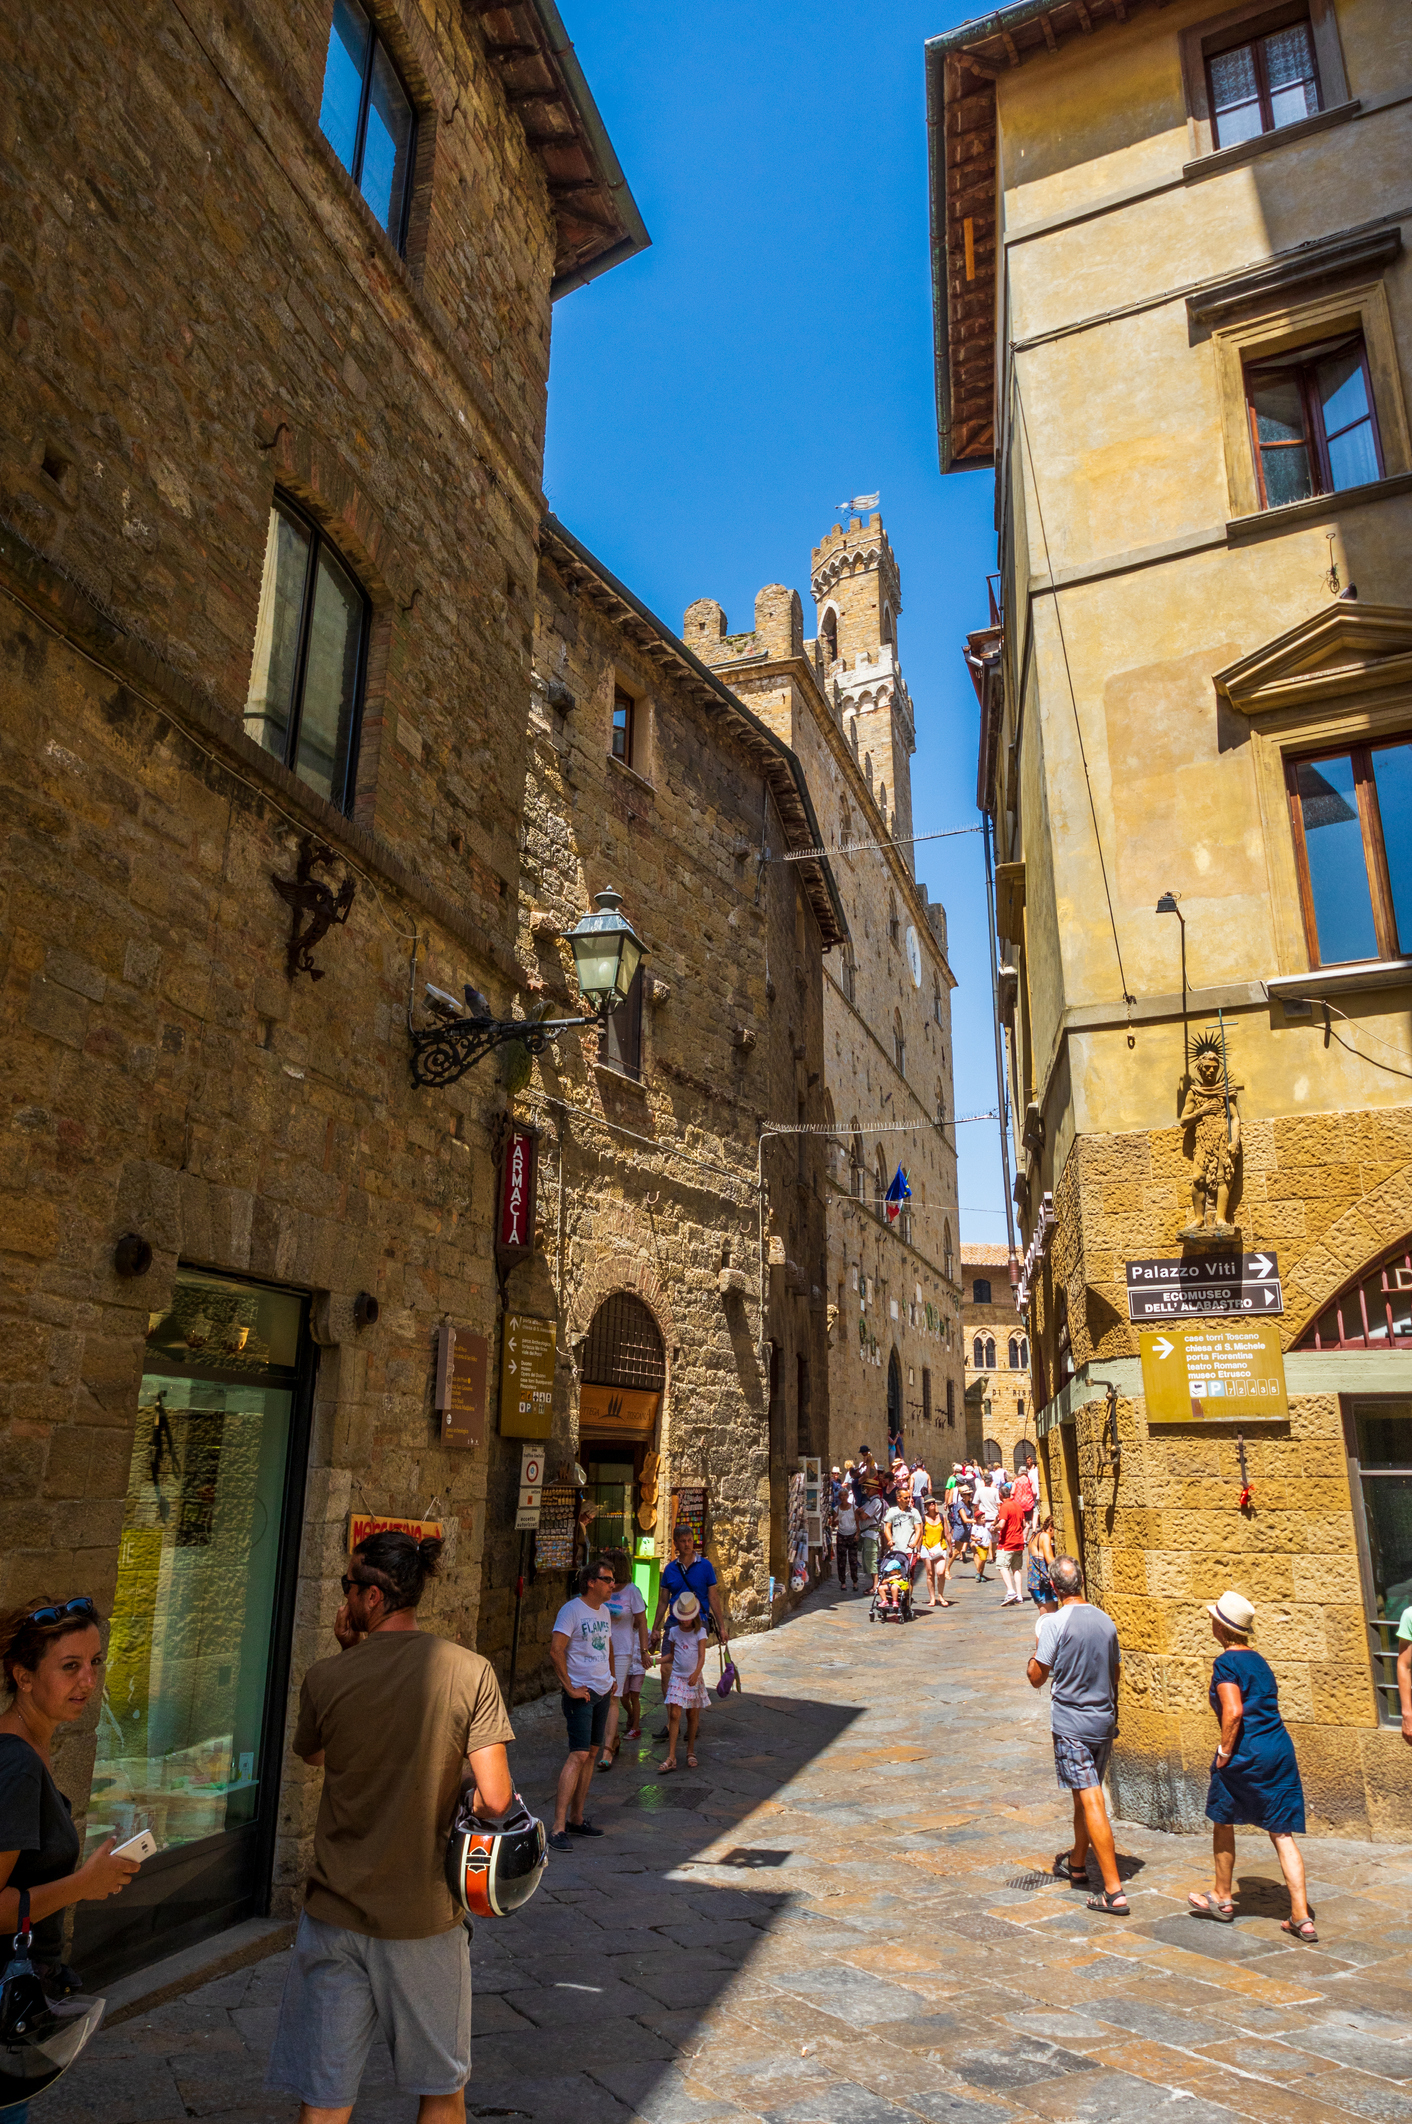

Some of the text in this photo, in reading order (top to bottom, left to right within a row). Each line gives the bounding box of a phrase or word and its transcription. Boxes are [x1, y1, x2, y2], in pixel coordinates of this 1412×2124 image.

[508, 1132, 524, 1245] FARMACIA
[1132, 1262, 1236, 1280] Palazzo Viti
[1162, 1289, 1231, 1302] ECOMUSEO
[1144, 1298, 1253, 1313] DELL' ALABASTRO
[1206, 1333, 1224, 1341] torri
[1225, 1332, 1260, 1340] Toscano
[1185, 1342, 1266, 1352] chiesa di S. Michele
[1186, 1352, 1254, 1362] porta Fiorentina
[1187, 1361, 1248, 1371] teatro Romano
[1188, 1370, 1252, 1379] museo Etrusco
[1209, 1381, 1221, 1396] P
[580, 1406, 600, 1416] OTTEGA
